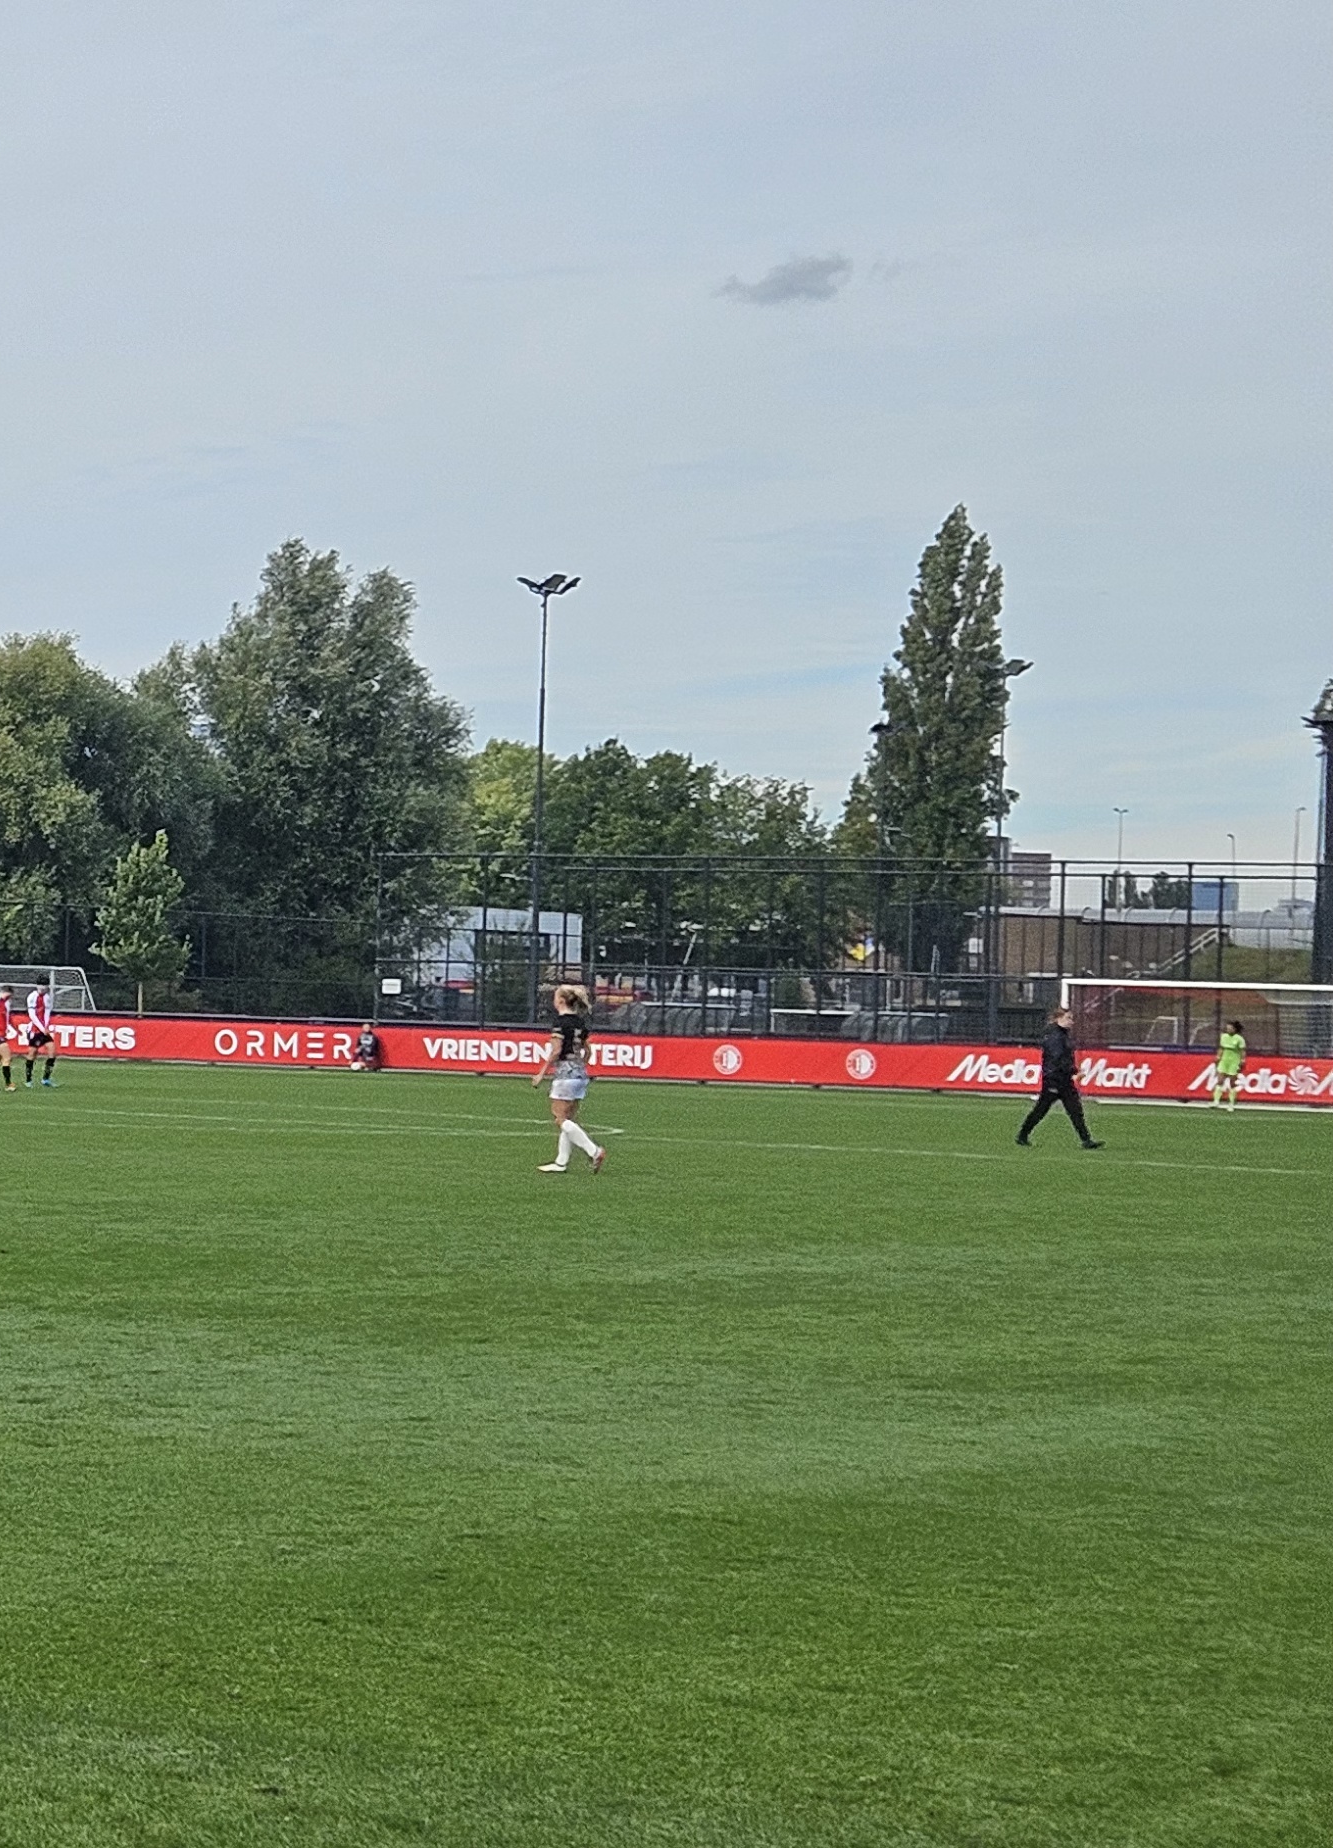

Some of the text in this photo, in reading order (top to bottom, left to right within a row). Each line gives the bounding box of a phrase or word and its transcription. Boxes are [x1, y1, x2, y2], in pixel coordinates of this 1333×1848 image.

[214, 1029, 352, 1061] ORMER
[946, 1054, 1152, 1089] Media Markt
